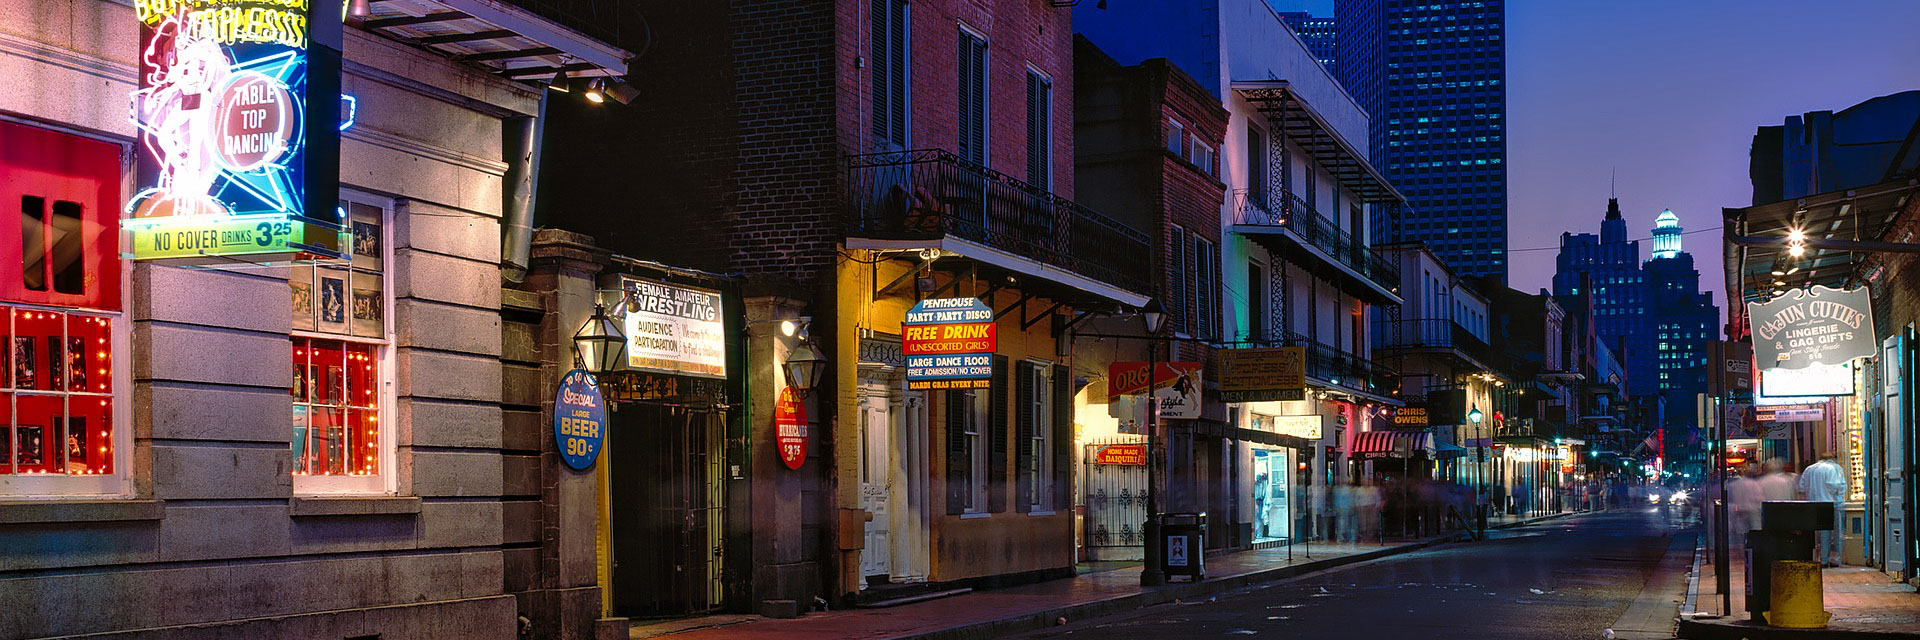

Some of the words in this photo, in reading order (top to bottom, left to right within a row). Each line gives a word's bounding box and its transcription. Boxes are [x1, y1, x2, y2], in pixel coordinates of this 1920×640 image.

[233, 84, 275, 106] TABLE
[241, 109, 267, 130] TOP
[154, 232, 171, 251] NO
[177, 230, 218, 249] COVER
[222, 230, 252, 243] DRINKS
[635, 282, 671, 299] FEMALE
[674, 290, 711, 307] AMATEUR
[922, 297, 975, 309] PENTHOUSE
[907, 312, 935, 323] PARTY
[936, 311, 964, 321] PARTY
[965, 309, 991, 320] DISCO
[1759, 302, 1806, 341] CAJUN
[1809, 300, 1866, 330] CUTIES
[638, 320, 673, 337] AUDIENCE
[906, 326, 938, 341] FREE
[943, 324, 991, 340] DRINK
[1785, 323, 1839, 339] LINGERIE
[909, 342, 963, 352] (UNESCORTED
[965, 341, 990, 351] GIRLS)
[1775, 341, 1784, 350] &
[1789, 337, 1814, 348] GAG
[1818, 331, 1854, 344] GIFTS
[908, 358, 934, 367] LARGE
[936, 357, 962, 367] DANCE
[964, 356, 990, 366] FLOOR
[907, 368, 923, 376] FREE
[970, 366, 992, 375] COVER
[909, 381, 931, 390] MARDI
[932, 381, 950, 389] GRAS
[951, 380, 972, 388] EVERY
[973, 380, 990, 388] NITE
[1223, 375, 1299, 387] BOTTOMLESS
[1221, 392, 1244, 402] MEN
[1260, 389, 1300, 400] WOMEN
[571, 409, 591, 419] LARGE
[1397, 407, 1426, 416] CHRIS
[1394, 415, 1429, 424] OWENS
[561, 416, 600, 439] BEER
[778, 424, 808, 437] HURRICANES
[567, 437, 587, 457] 90
